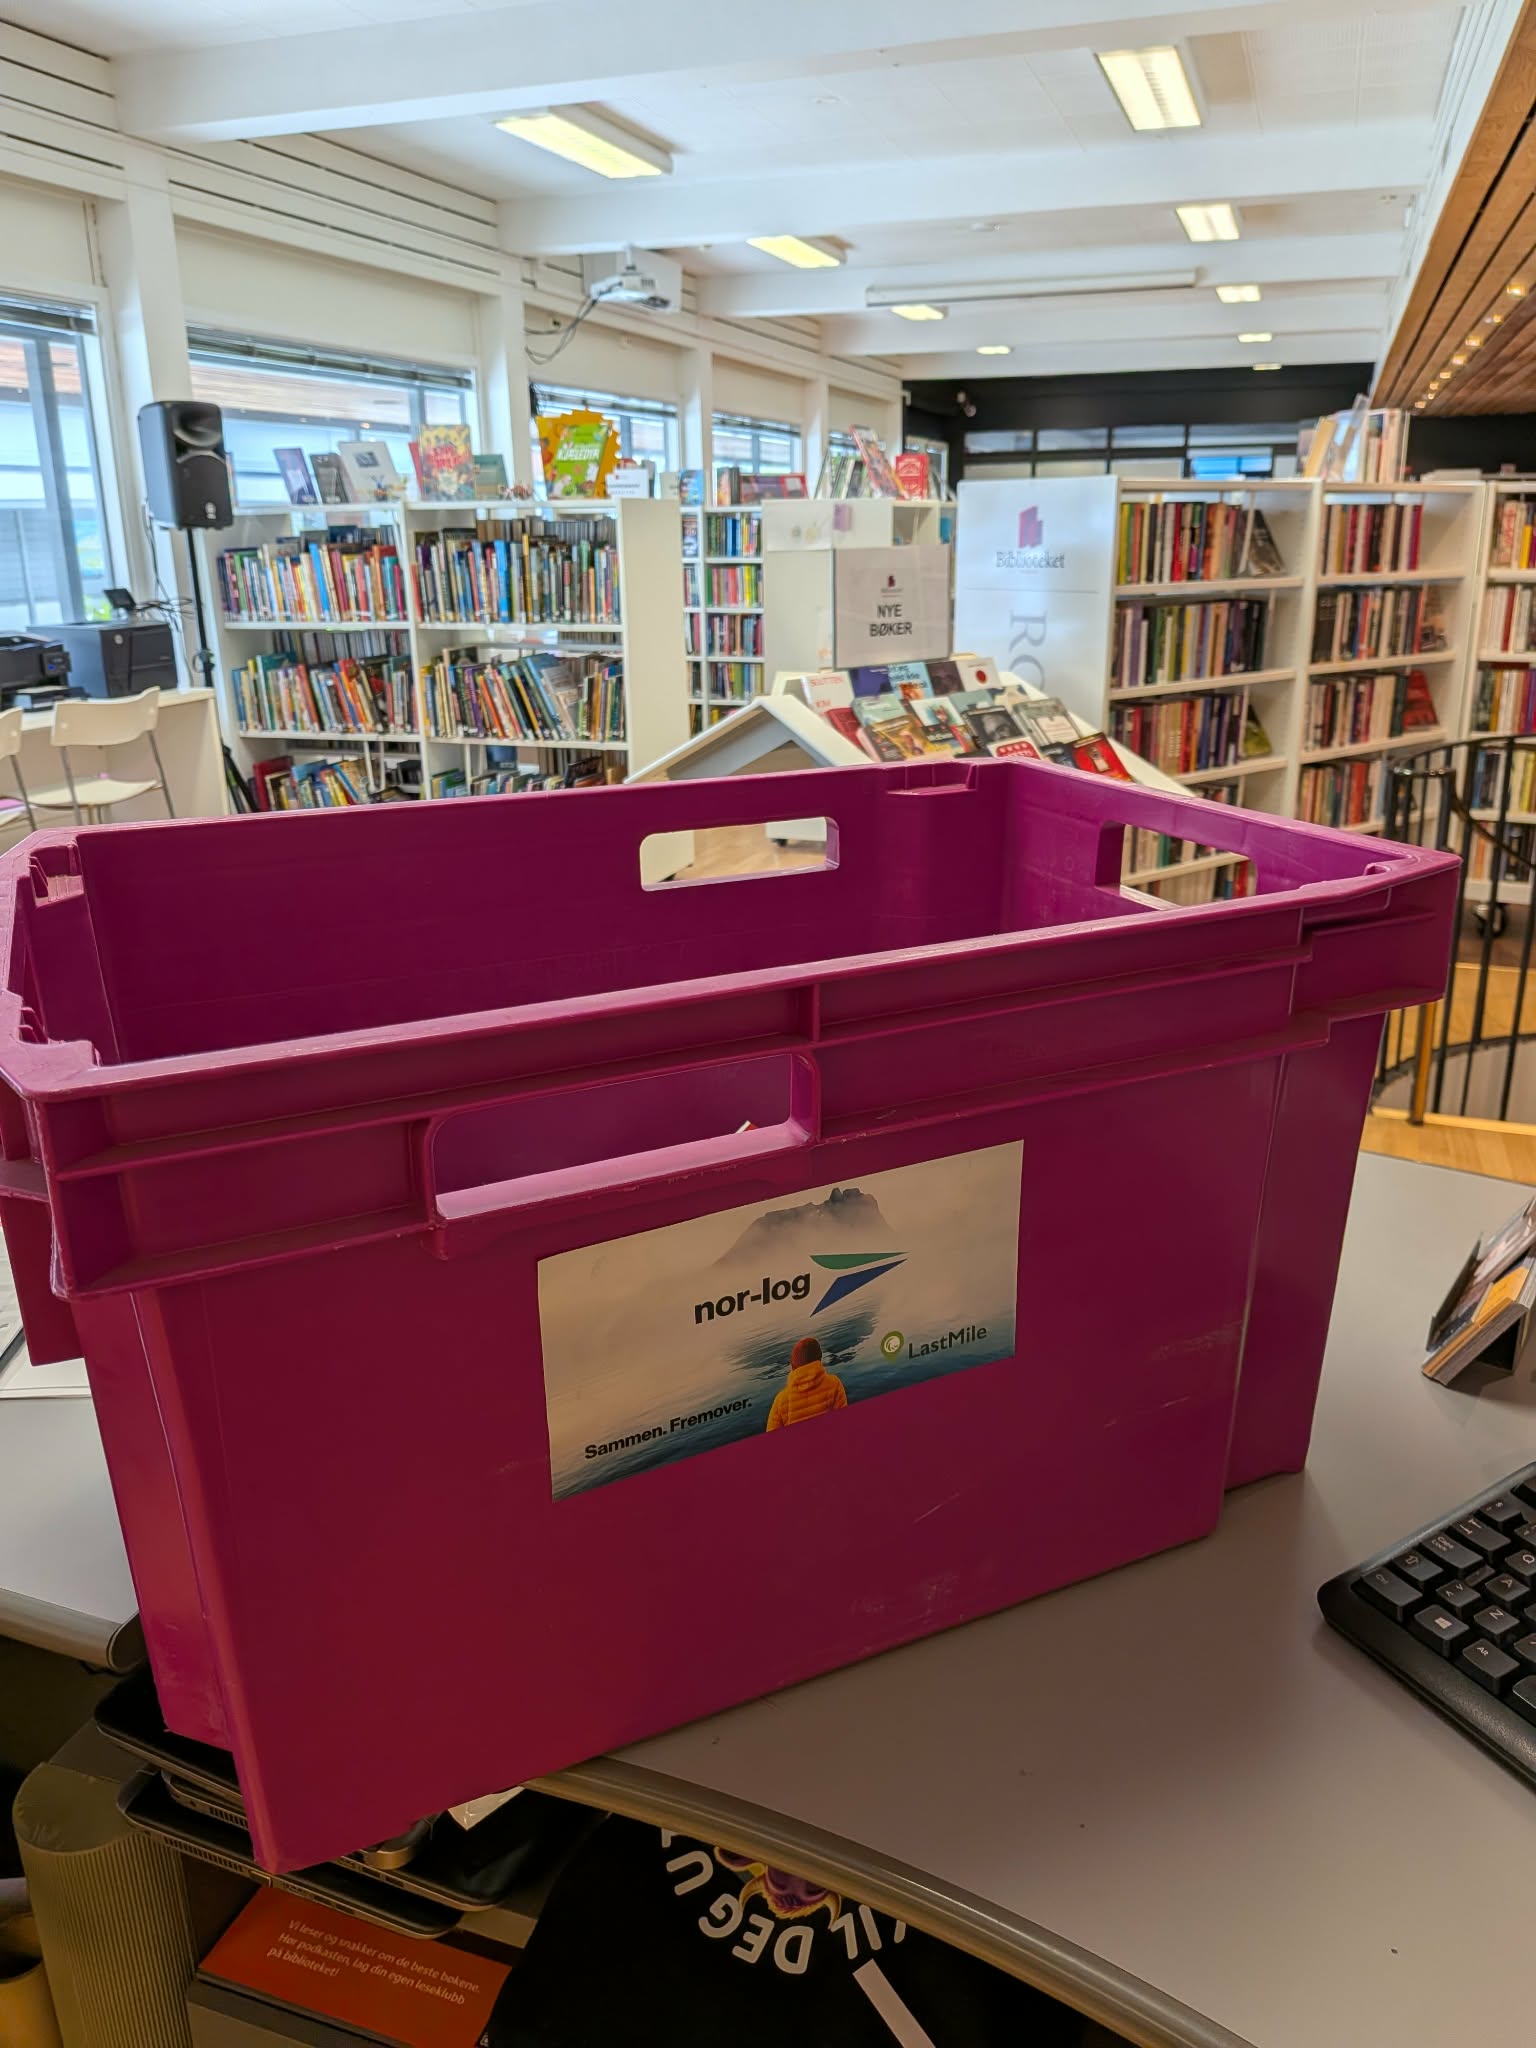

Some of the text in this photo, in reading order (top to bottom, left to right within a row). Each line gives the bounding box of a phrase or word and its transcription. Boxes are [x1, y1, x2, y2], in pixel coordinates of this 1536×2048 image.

[996, 552, 1065, 569] Biblioteket
[869, 622, 912, 637] BØKER
[876, 604, 903, 618] NYE
[694, 1272, 812, 1324] nor-log
[908, 1325, 988, 1361] LastMile
[585, 1396, 752, 1459] Sammen. Fremover.
[289, 1919, 301, 1930] Vi
[299, 1924, 324, 1939] leser
[324, 1933, 338, 1945] og
[338, 1938, 378, 1956] snakker
[378, 1952, 395, 1964] om
[396, 1957, 410, 1969] de
[410, 1961, 440, 1979] beste
[698, 1893, 814, 1974] DEG
[267, 1947, 341, 1977] på biblioteket!
[353, 1958, 369, 1973] lag
[370, 1965, 387, 1977] din
[388, 1971, 415, 1987] egen
[415, 1979, 465, 2005] leseklubb
